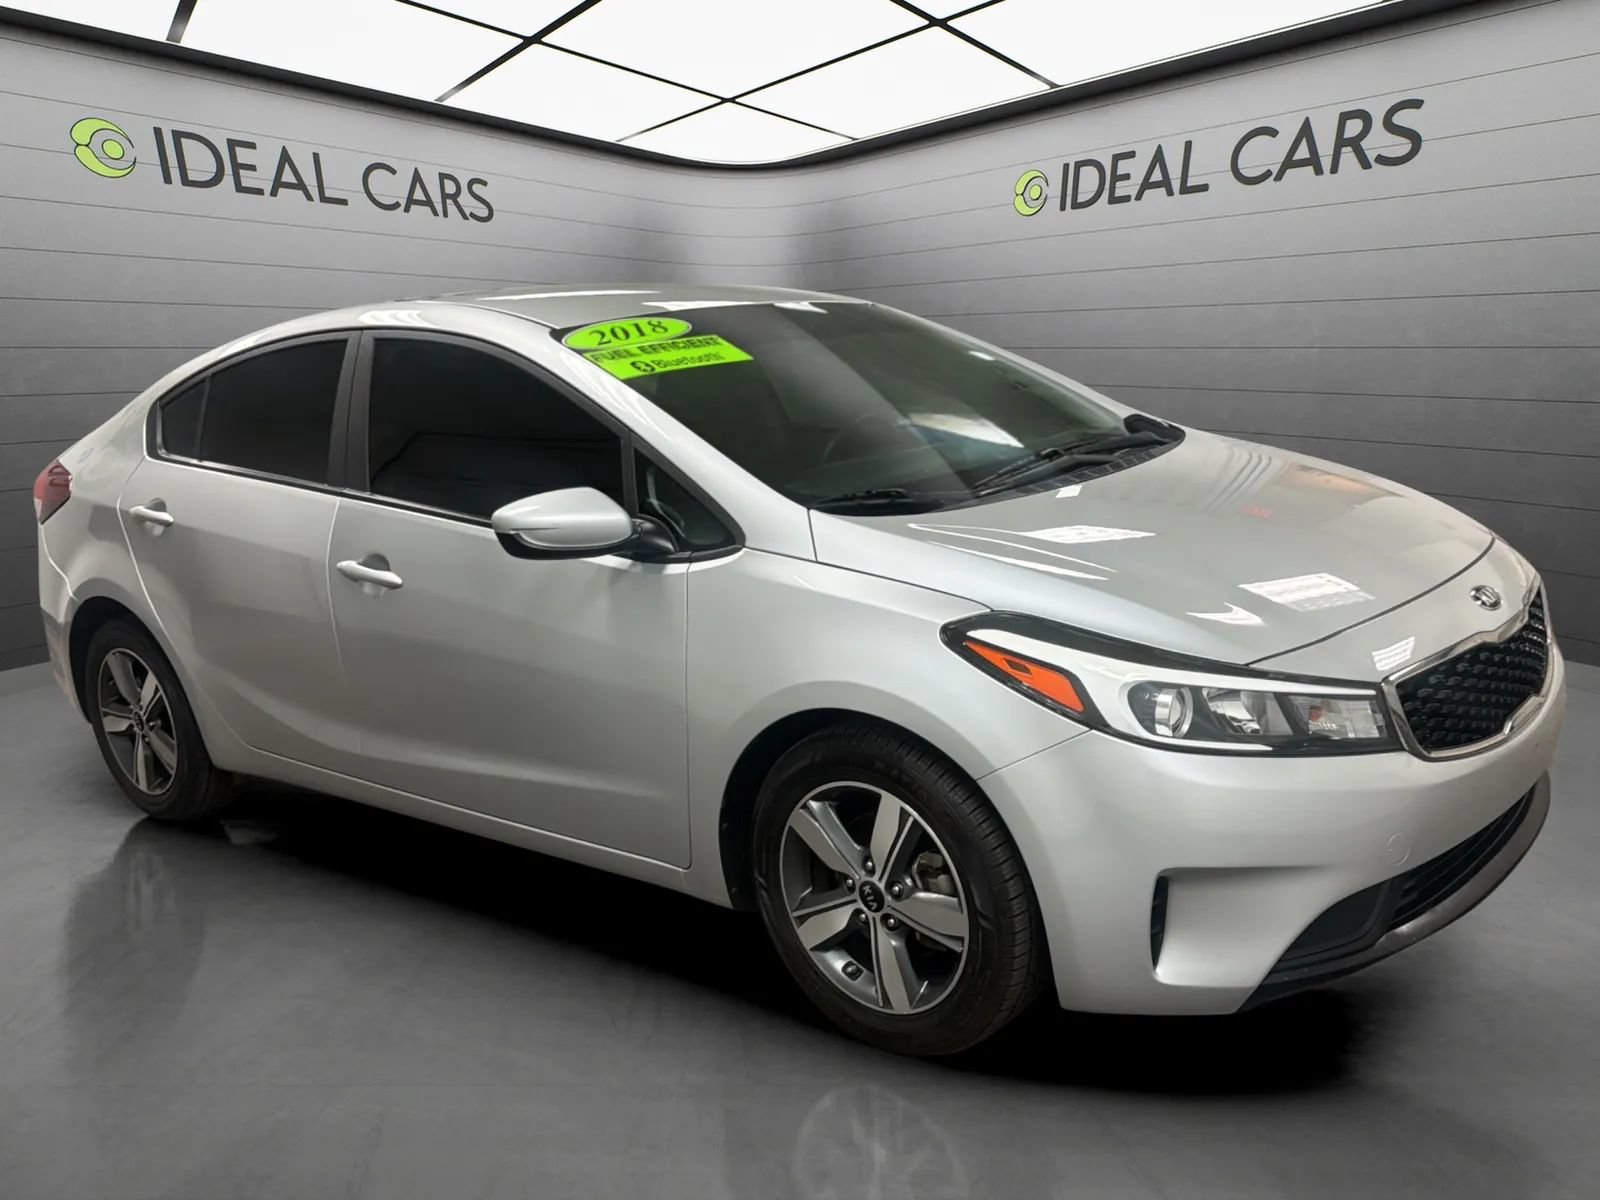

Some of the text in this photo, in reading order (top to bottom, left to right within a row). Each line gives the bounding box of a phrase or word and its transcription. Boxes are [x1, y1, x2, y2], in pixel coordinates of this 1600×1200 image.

[153, 126, 495, 223] IDEAL CARS
[1059, 98, 1425, 212] IDEAL CARS
[589, 320, 668, 345] 2018
[638, 336, 722, 354] EFFICIENT
